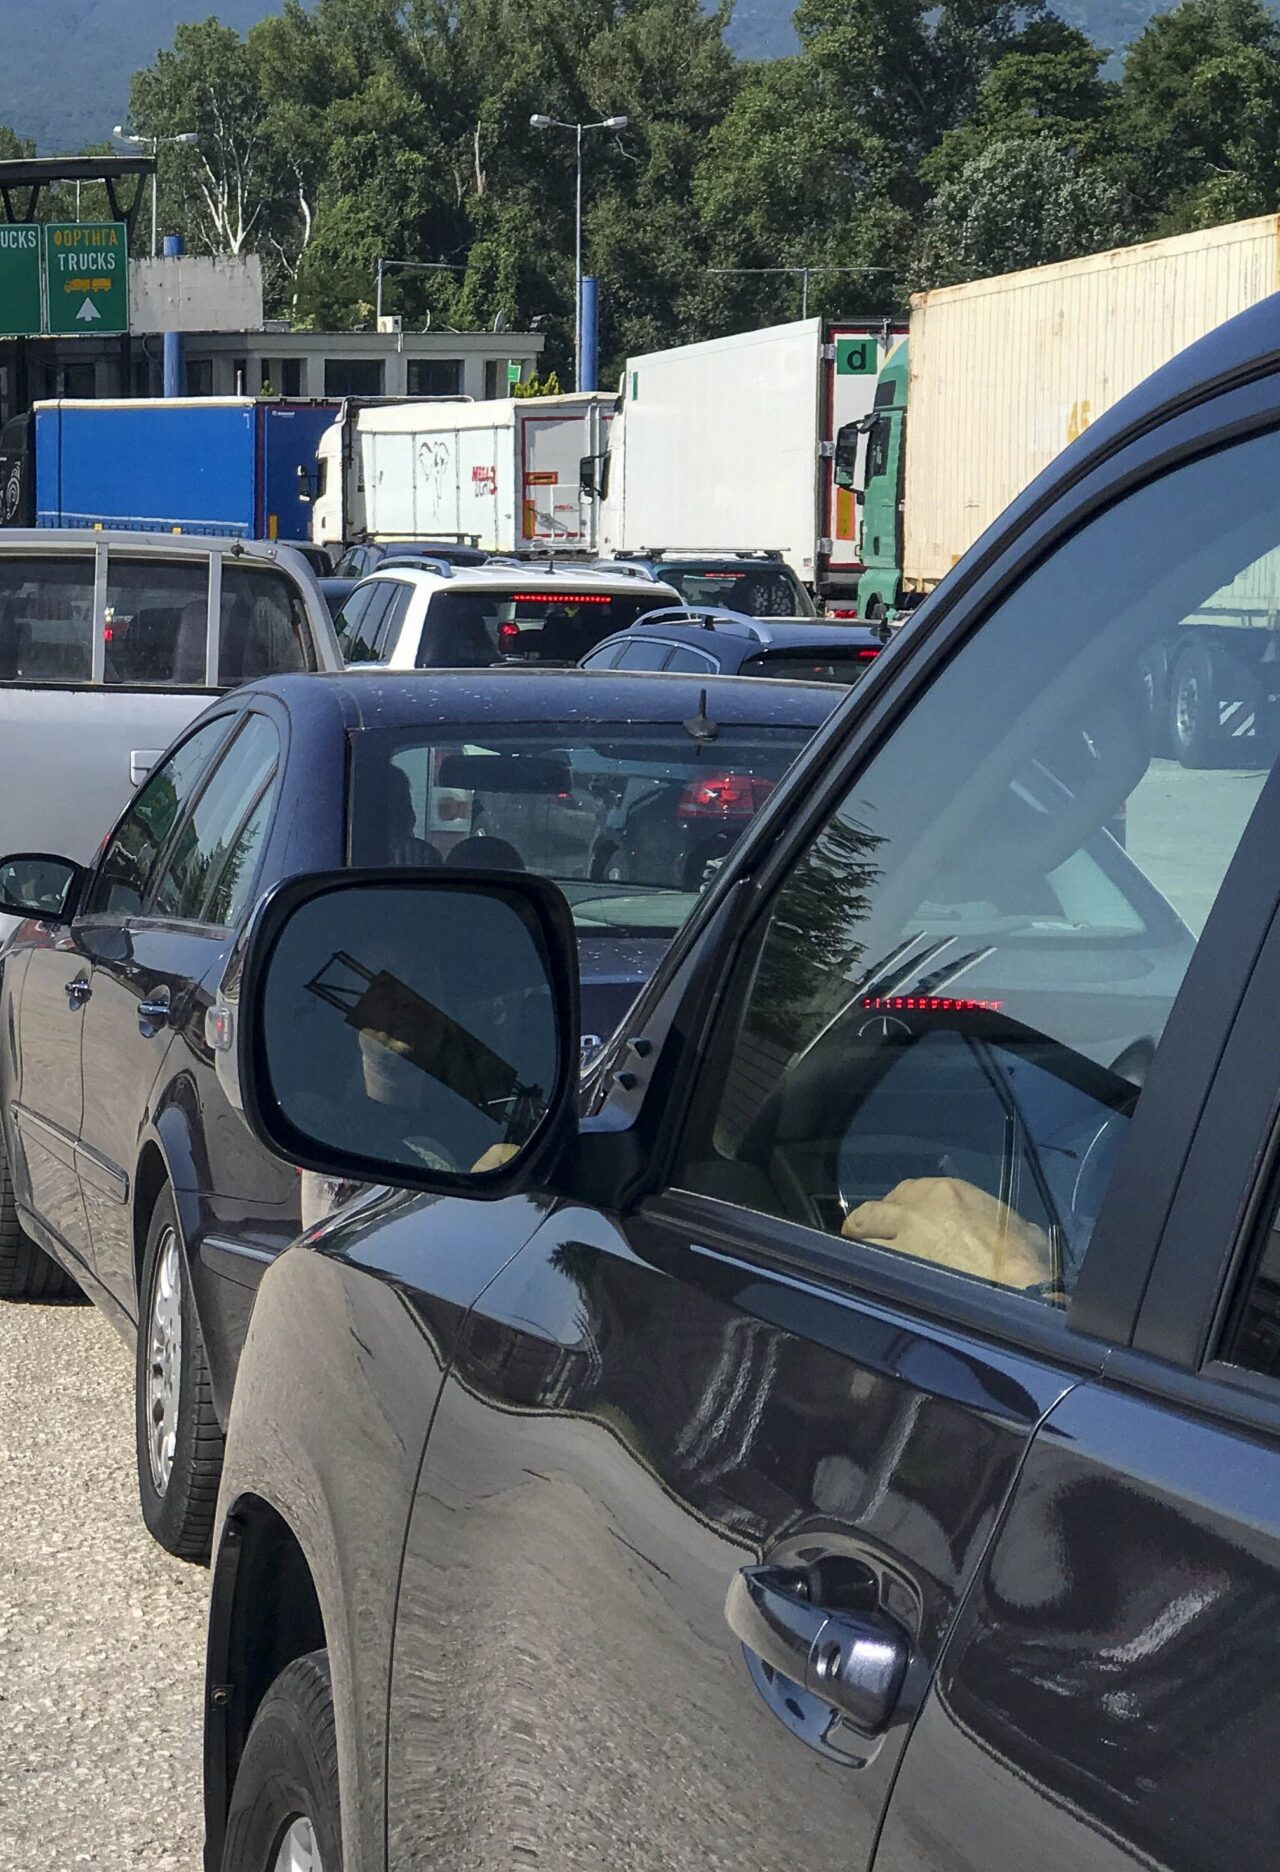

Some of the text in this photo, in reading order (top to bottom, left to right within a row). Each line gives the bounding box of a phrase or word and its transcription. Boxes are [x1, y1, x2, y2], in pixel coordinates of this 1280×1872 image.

[53, 229, 119, 247] ΦΟΡΤΗΓΑ
[57, 252, 116, 271] TRUCKS
[846, 344, 867, 371] d
